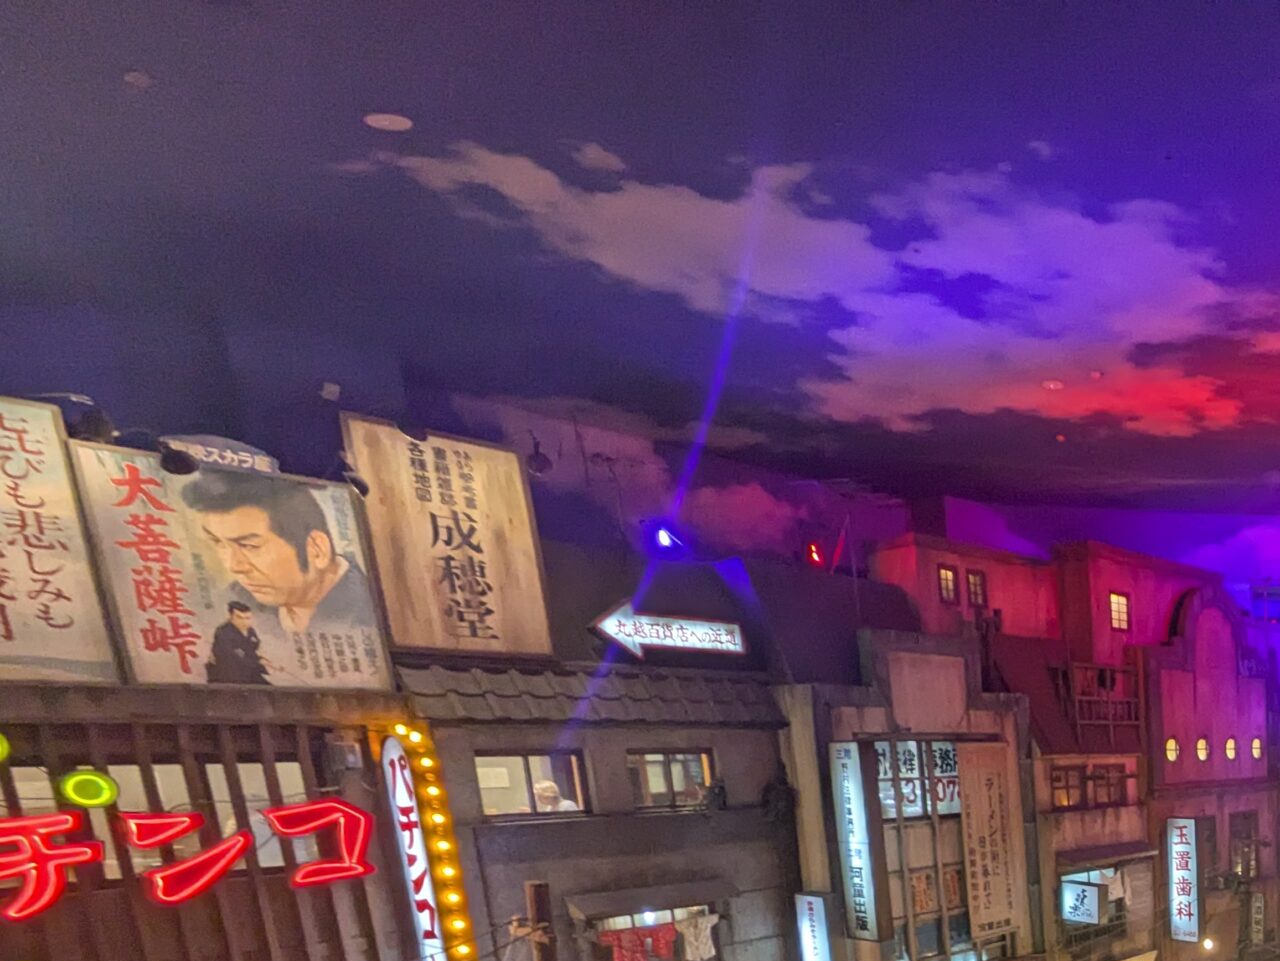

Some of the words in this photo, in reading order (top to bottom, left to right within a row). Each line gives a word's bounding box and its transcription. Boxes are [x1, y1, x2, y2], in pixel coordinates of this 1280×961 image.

[110, 462, 202, 675] 大菩薩峠
[389, 754, 438, 939] パチンコ
[1172, 825, 1194, 922] 玉置歯科
